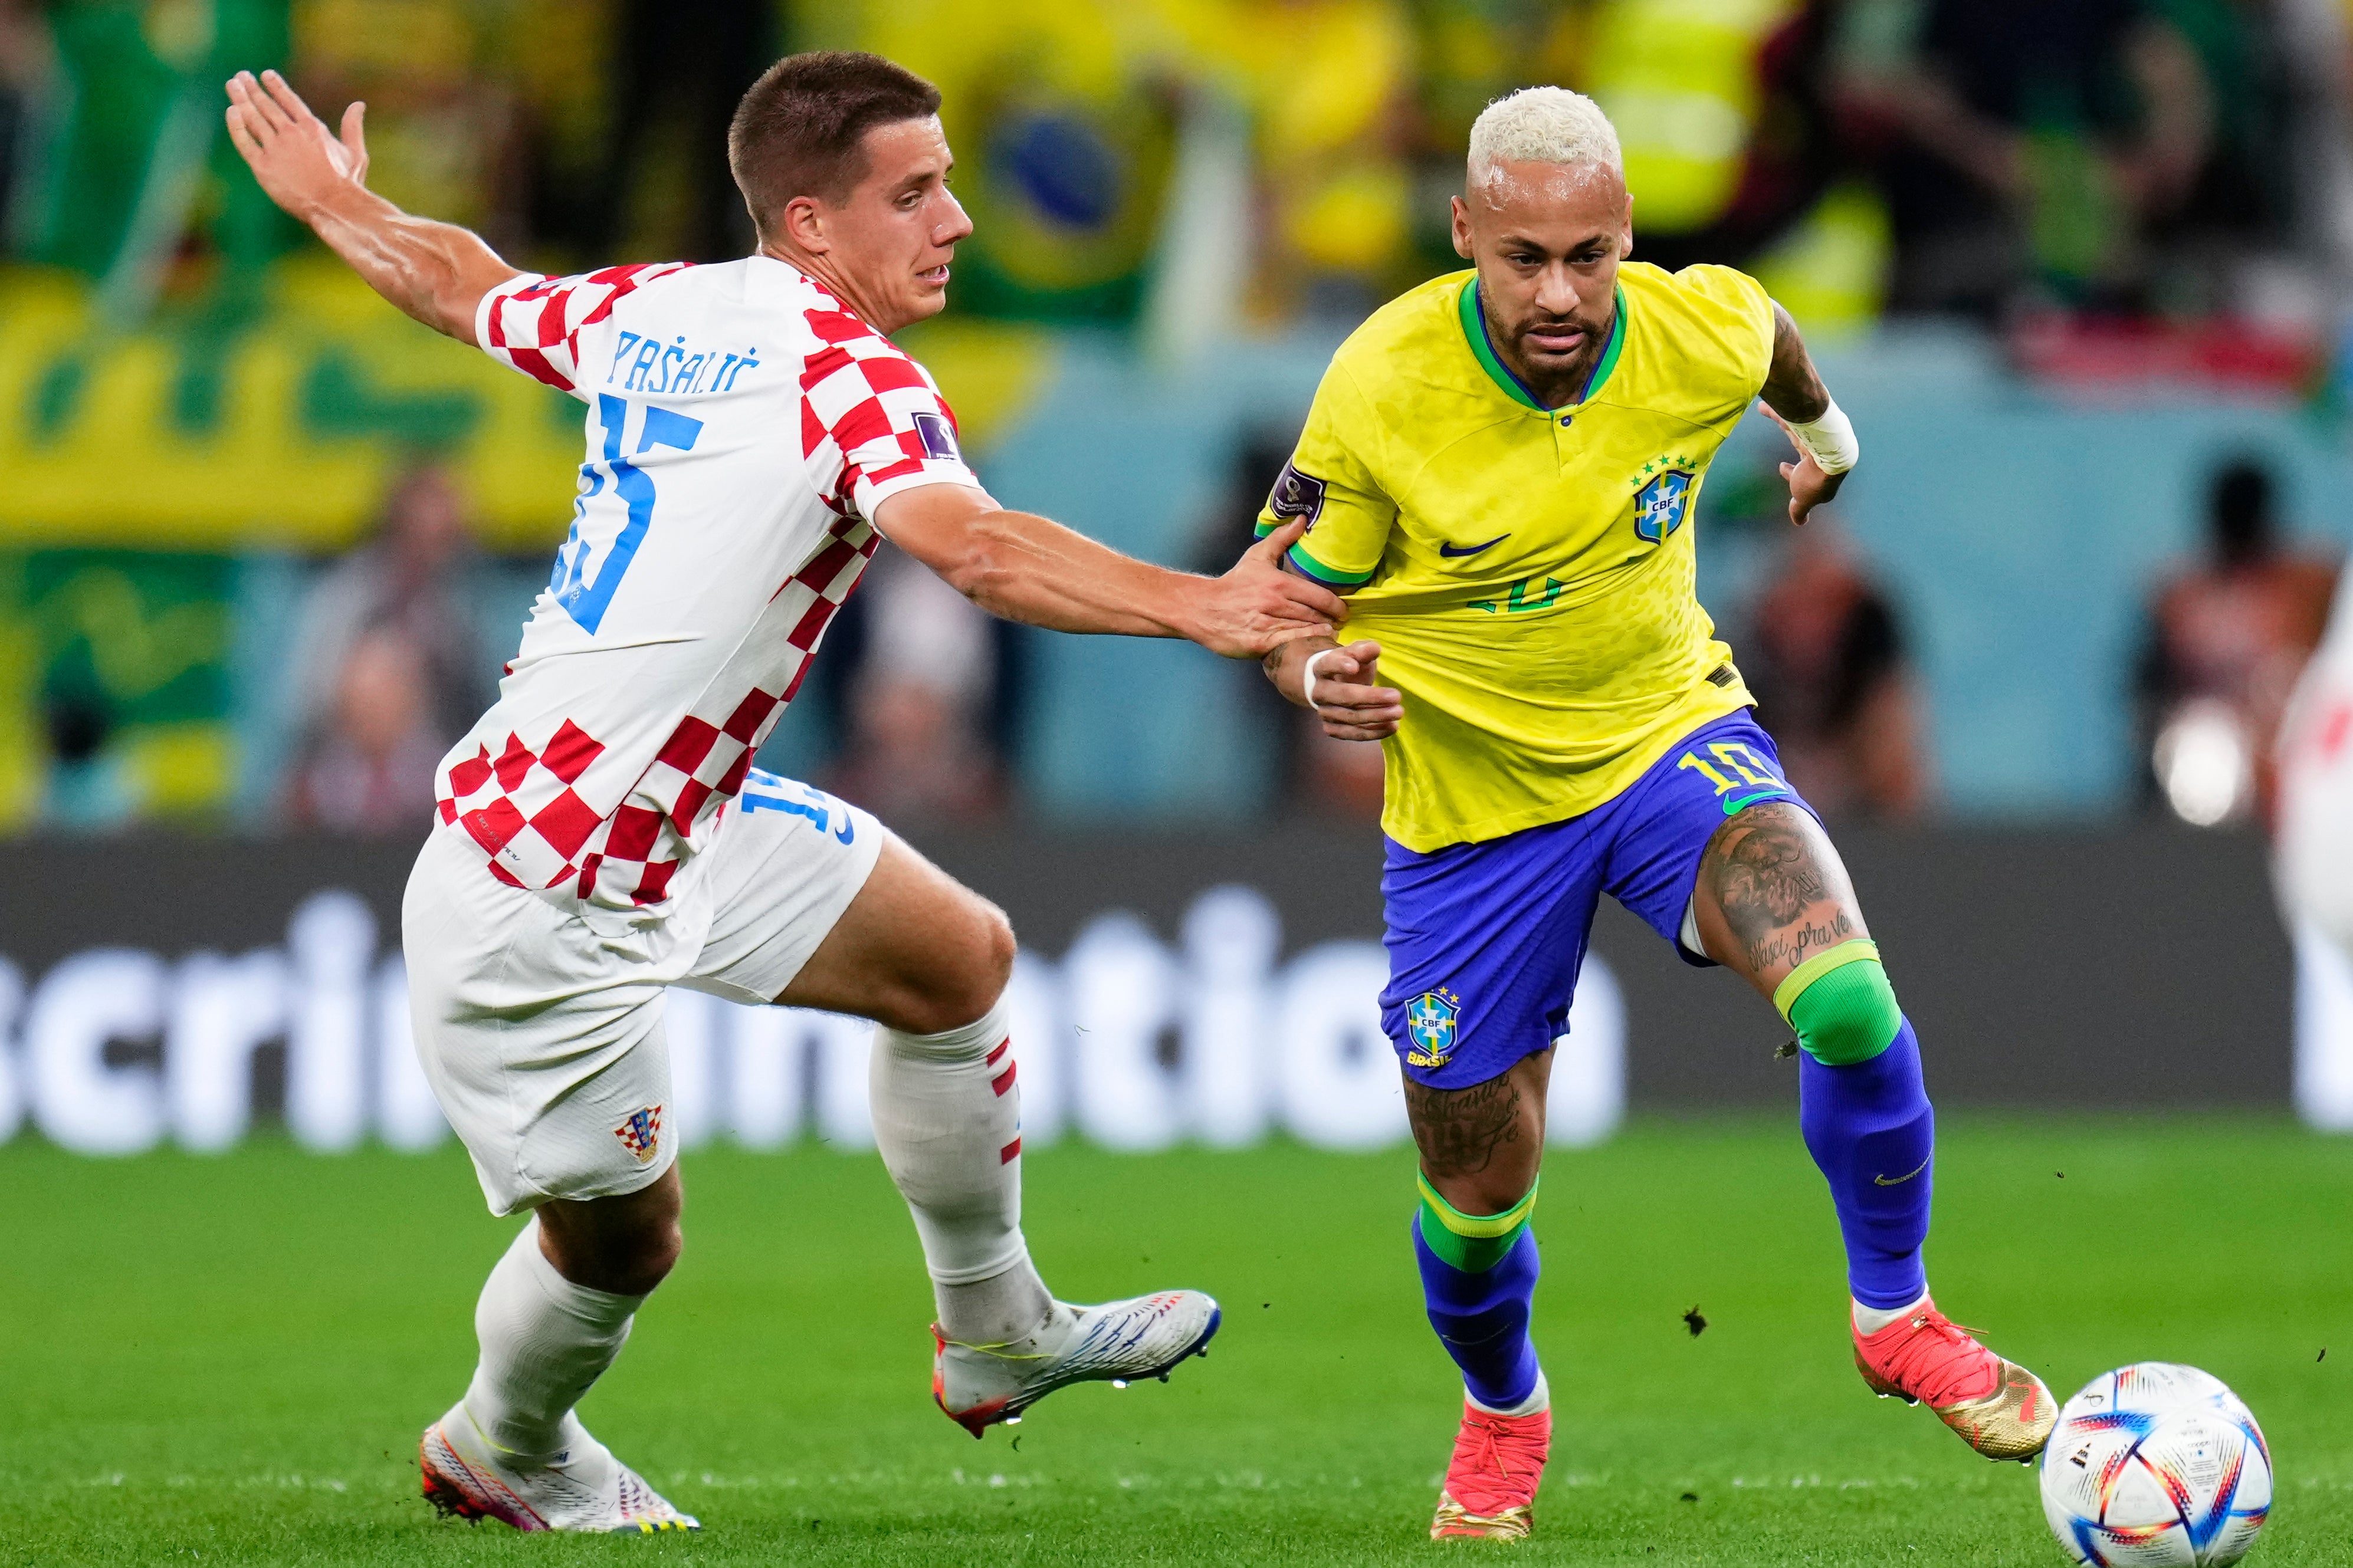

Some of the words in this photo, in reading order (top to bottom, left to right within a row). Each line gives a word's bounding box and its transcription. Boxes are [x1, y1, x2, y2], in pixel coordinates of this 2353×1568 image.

[1652, 497, 1673, 512] CBF
[1676, 742, 1788, 797] 10
[1422, 1019, 1440, 1027] CBF
[1407, 1051, 1453, 1067] BRASIL
